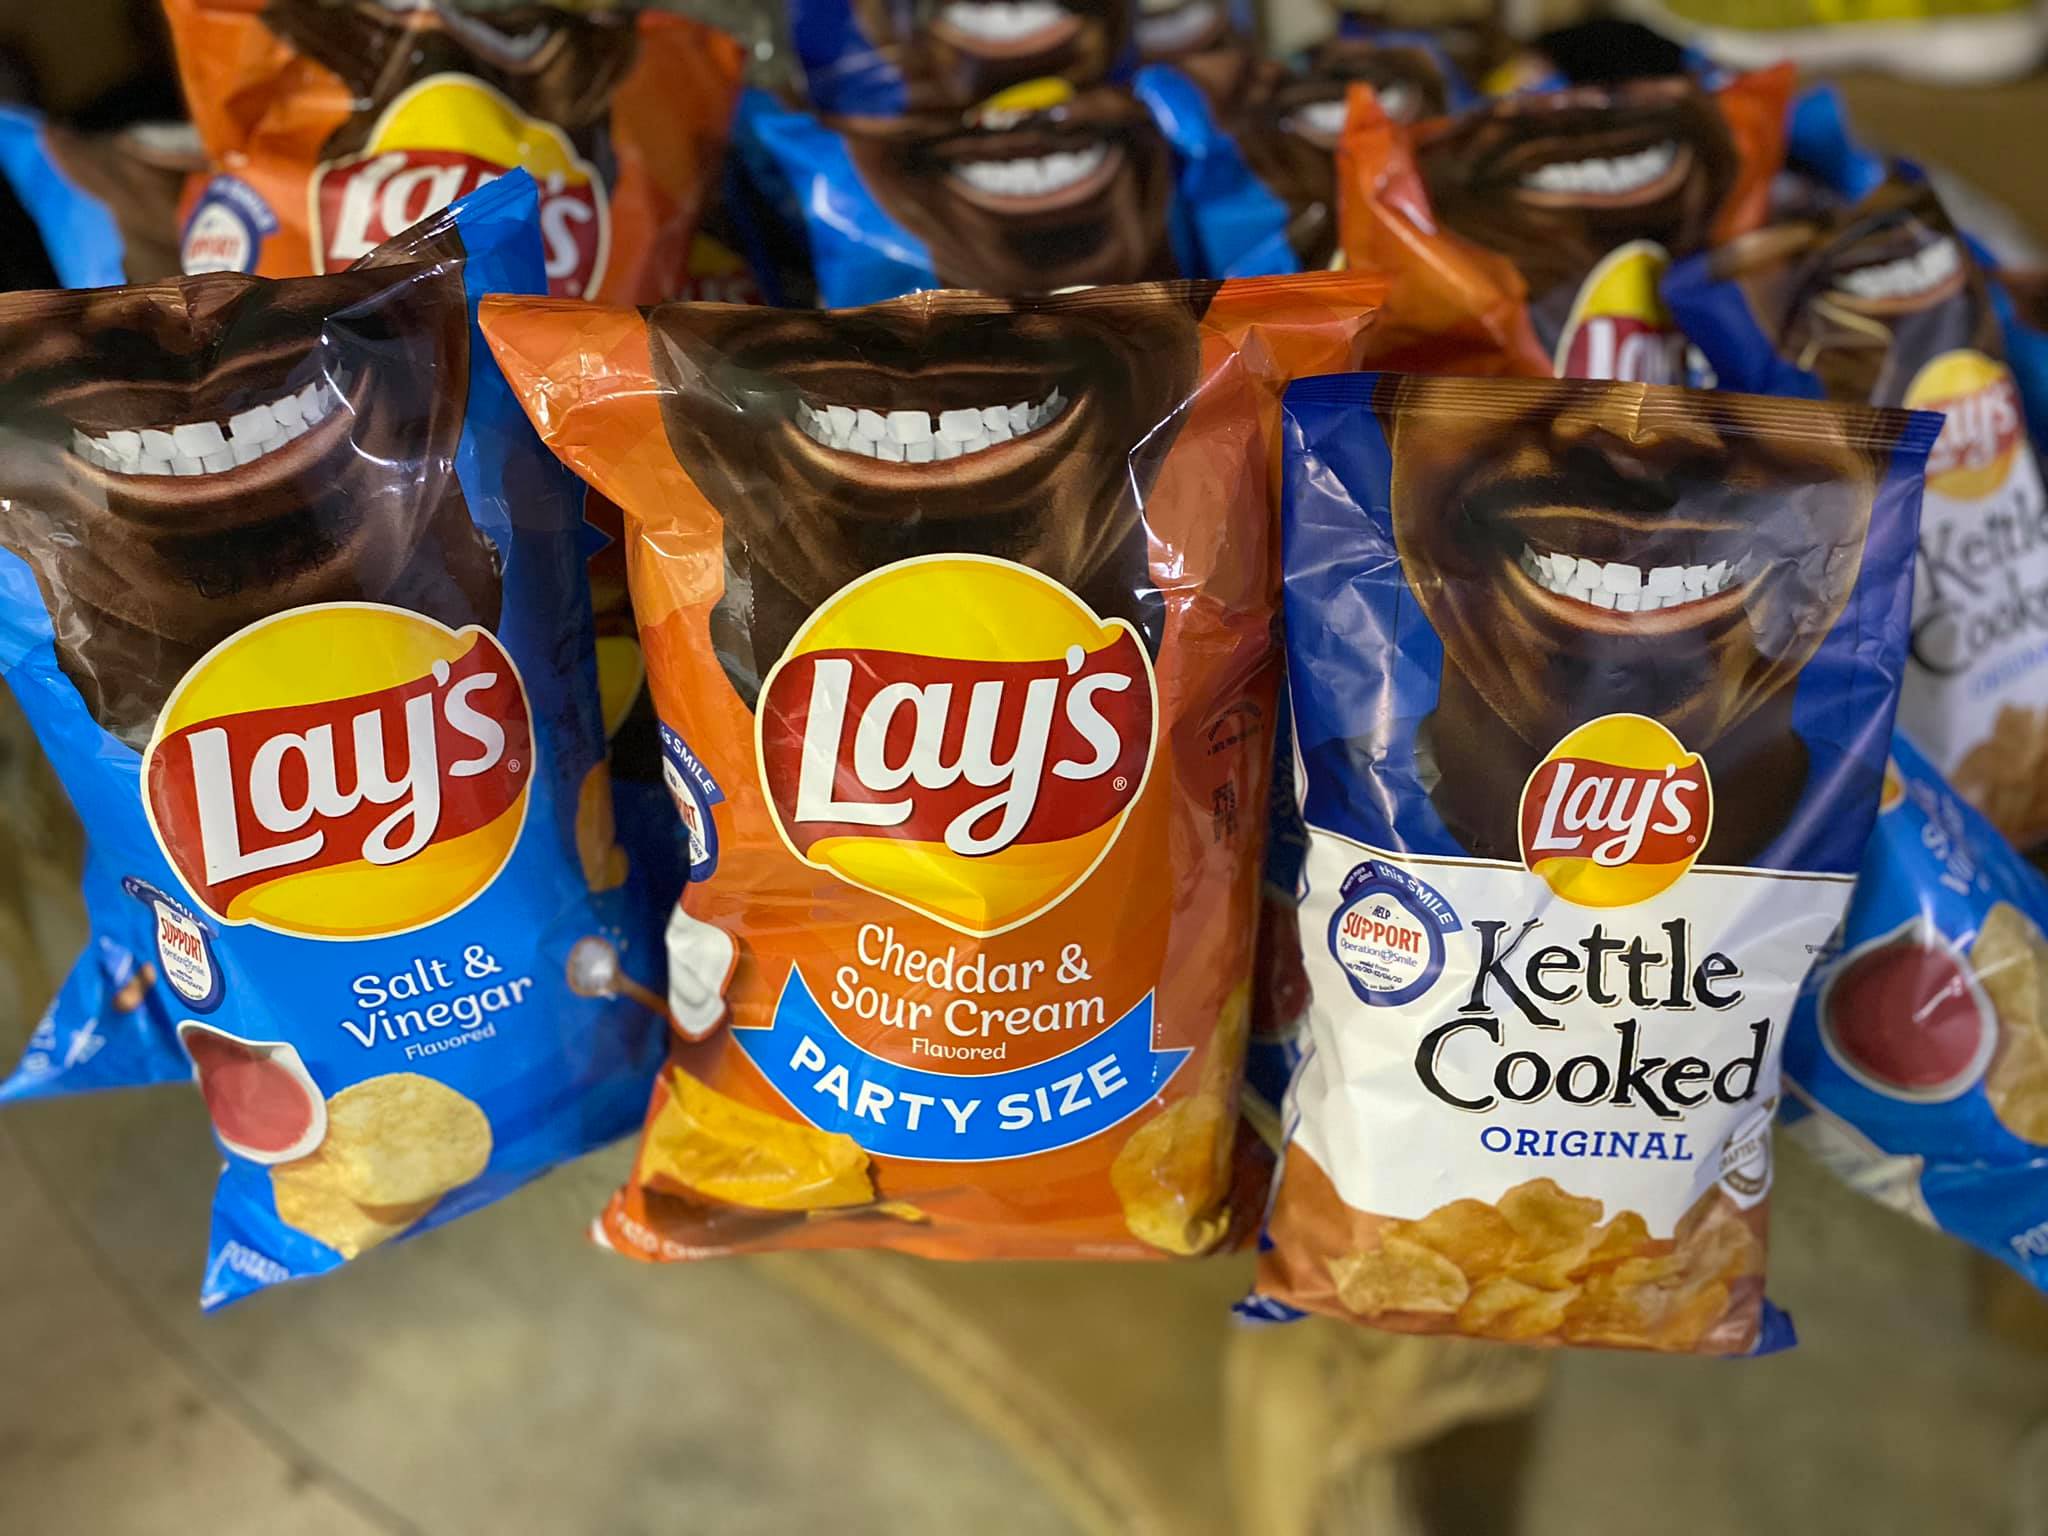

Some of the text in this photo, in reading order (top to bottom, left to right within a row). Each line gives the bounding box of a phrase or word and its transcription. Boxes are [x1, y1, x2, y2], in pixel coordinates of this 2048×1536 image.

[328, 152, 592, 279] La's
[186, 659, 506, 887] Lay's
[672, 737, 716, 795] SMILE
[794, 644, 1133, 856] Lay's
[1531, 762, 1699, 867] Lay's
[1371, 904, 1391, 920] HELP
[1379, 863, 1454, 925] this SMILE
[857, 923, 1093, 995] Cheddar &
[1340, 937, 1418, 968] Operation Smile
[1342, 911, 1423, 954] SUPPORT
[352, 944, 503, 1009] Salt &
[831, 965, 1106, 1038] Sour Cream
[1457, 917, 1745, 1029] Kettle
[340, 976, 534, 1049] Vinegar
[403, 1021, 497, 1061] Flavored
[788, 1034, 1129, 1135] PARTY SIZE
[910, 1037, 1008, 1061] Flavored
[1414, 1017, 1772, 1119] Cooked
[1480, 1125, 1694, 1162] ORIGINAL
